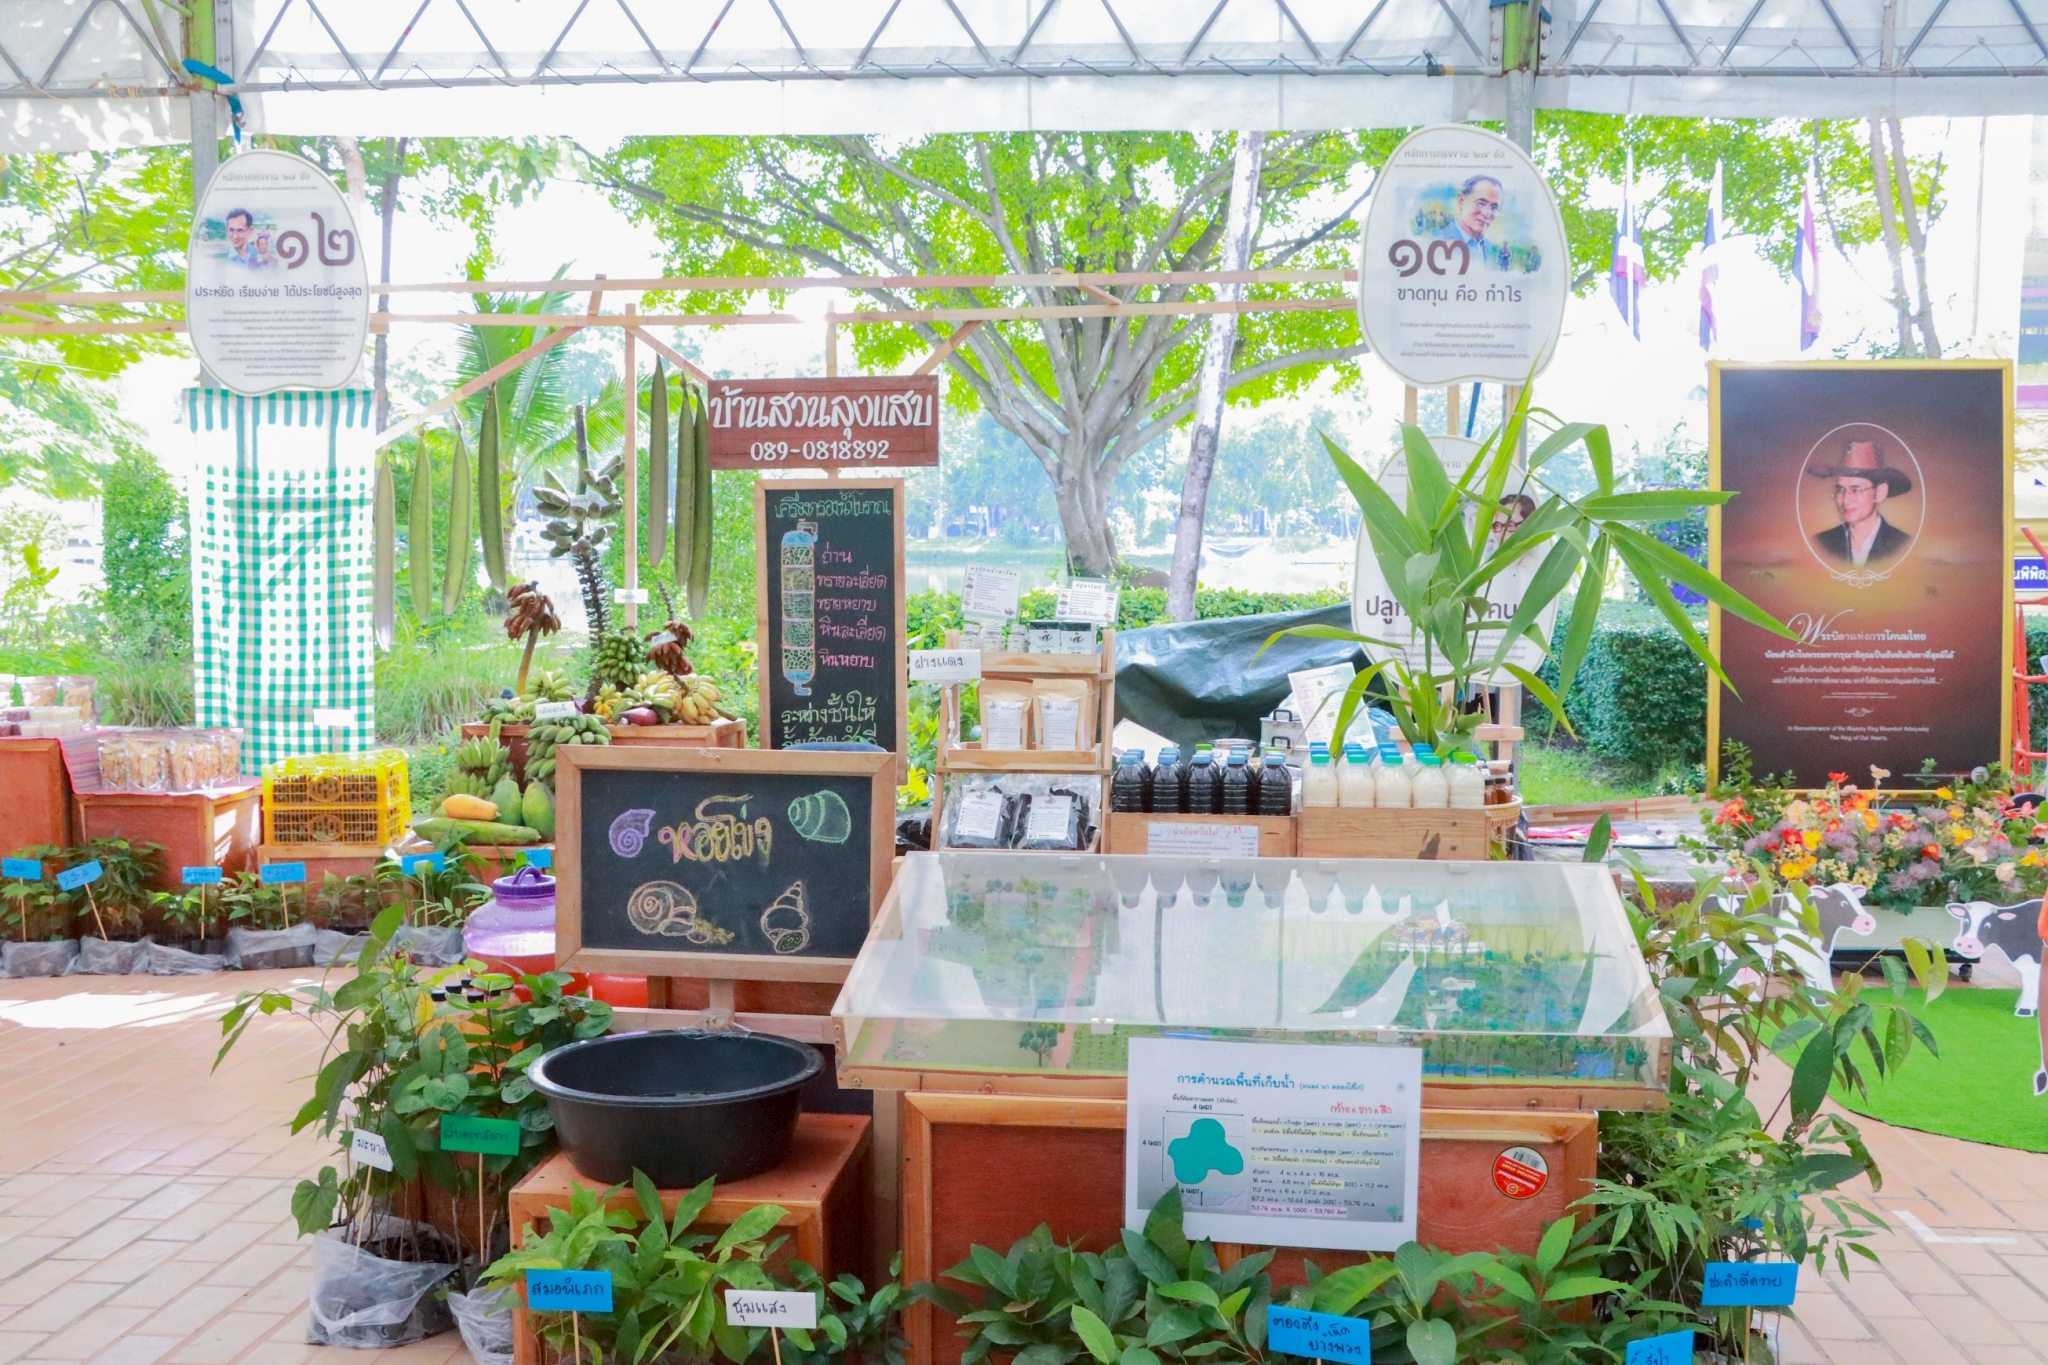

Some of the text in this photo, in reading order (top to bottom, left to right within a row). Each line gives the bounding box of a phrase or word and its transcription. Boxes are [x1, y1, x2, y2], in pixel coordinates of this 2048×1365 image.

[275, 211, 355, 270] ๑๒
[238, 285, 280, 298] เรียบง่าย
[283, 284, 362, 301] ได้ประโยชน์สูงสุด
[1397, 283, 1523, 307] ขาดทุน คือ กำไร
[709, 385, 934, 441] บ้านสวนลุงแสบ
[750, 439, 890, 462] 089-0818892
[914, 655, 964, 669] ฝางแดง
[1176, 1071, 1296, 1089] การคำนวณพื้นที่เก็บน้ำ
[1330, 1102, 1350, 1114] กว้าง
[1358, 1106, 1373, 1114] ยาว
[1251, 1204, 1269, 1212] 53.76
[530, 1277, 605, 1296] สมอพิเภก
[1708, 1269, 1783, 1288] ประคำดีควาย
[732, 1297, 787, 1322] ชุมแสง
